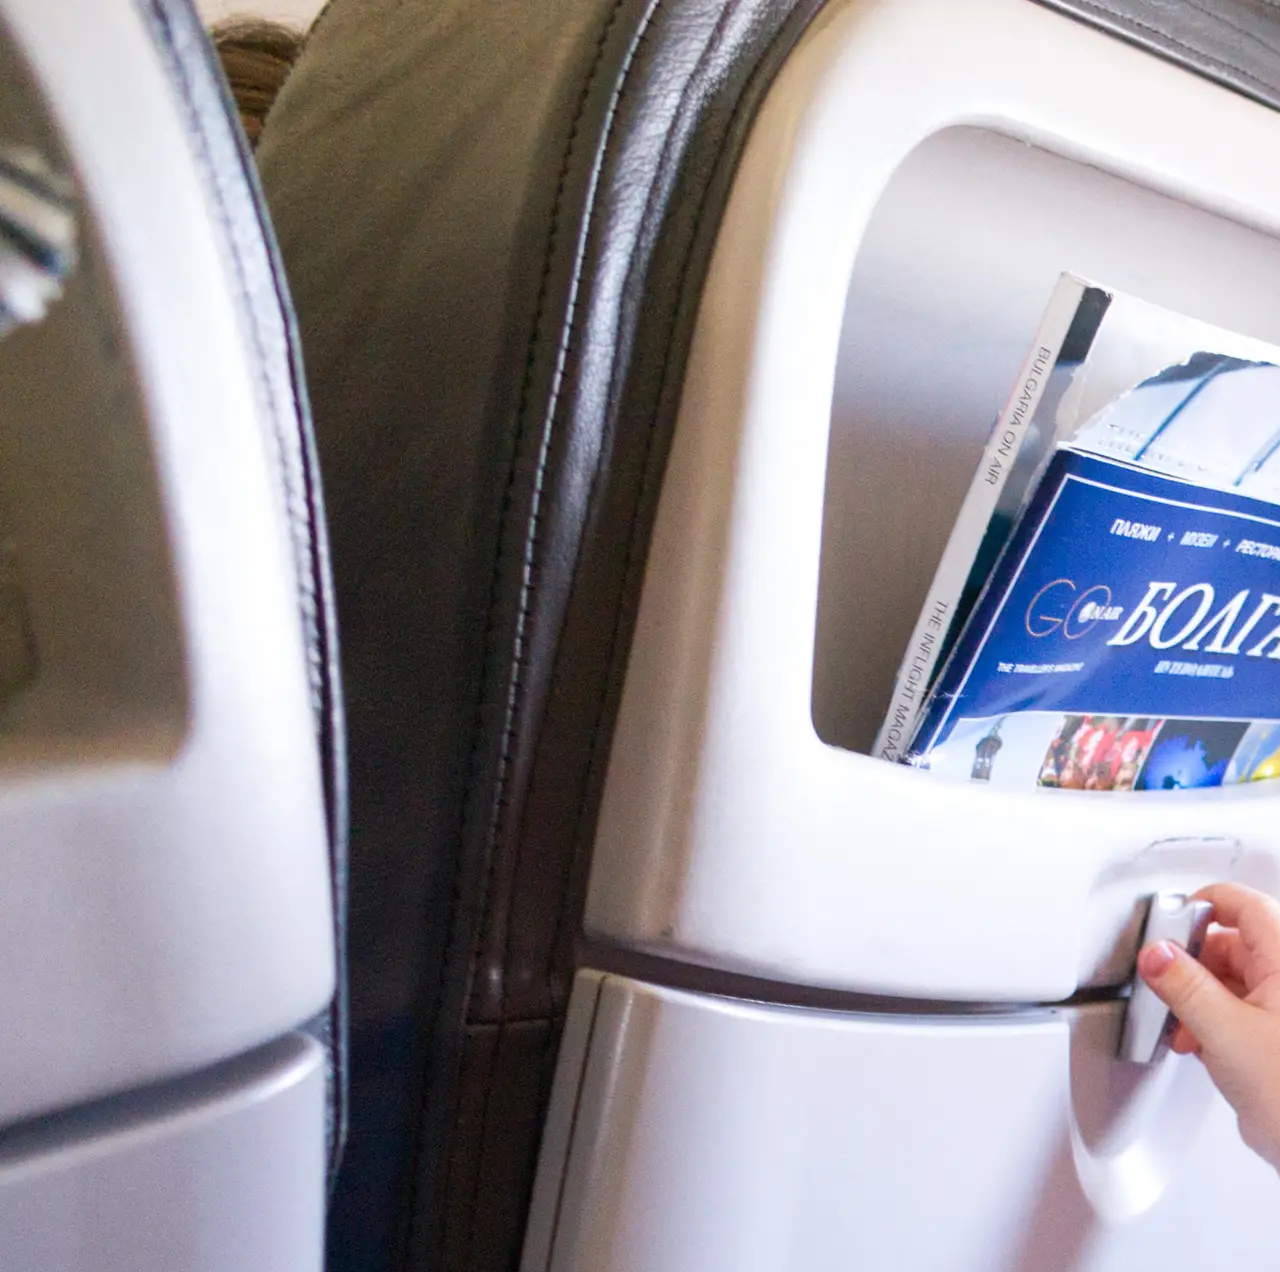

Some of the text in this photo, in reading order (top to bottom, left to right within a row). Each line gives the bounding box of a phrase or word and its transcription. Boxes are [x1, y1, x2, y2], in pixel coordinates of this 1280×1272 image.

[984, 346, 1051, 485] BULGARIA ON AIR
[1109, 518, 1162, 542] ПЛЯЖИ
[927, 601, 949, 632] THE
[904, 631, 936, 702] INFLIGHT
